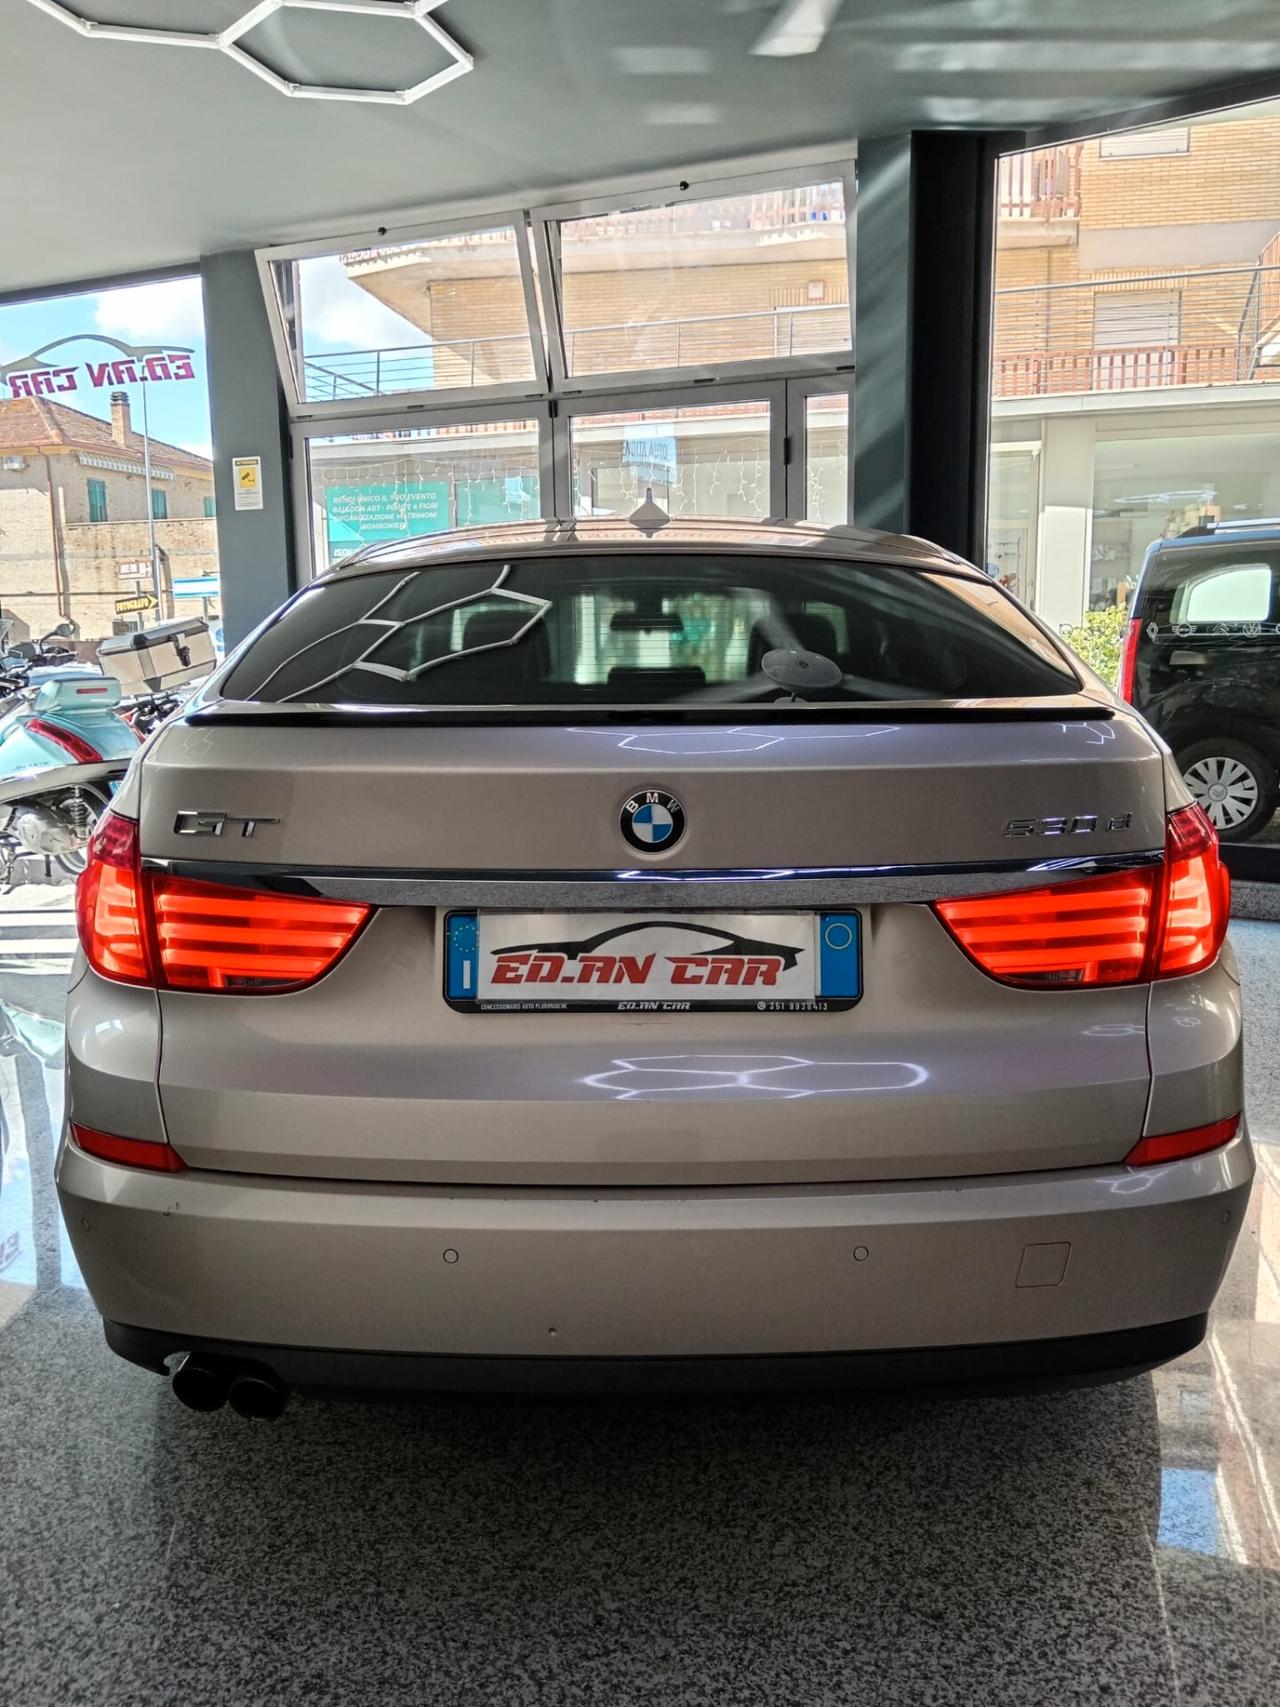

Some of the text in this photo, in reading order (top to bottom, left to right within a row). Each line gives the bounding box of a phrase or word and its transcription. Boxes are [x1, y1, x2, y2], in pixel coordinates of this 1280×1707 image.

[174, 810, 280, 838] GT
[491, 953, 785, 986] ED.AN CAR
[662, 1002, 691, 1010] CAR
